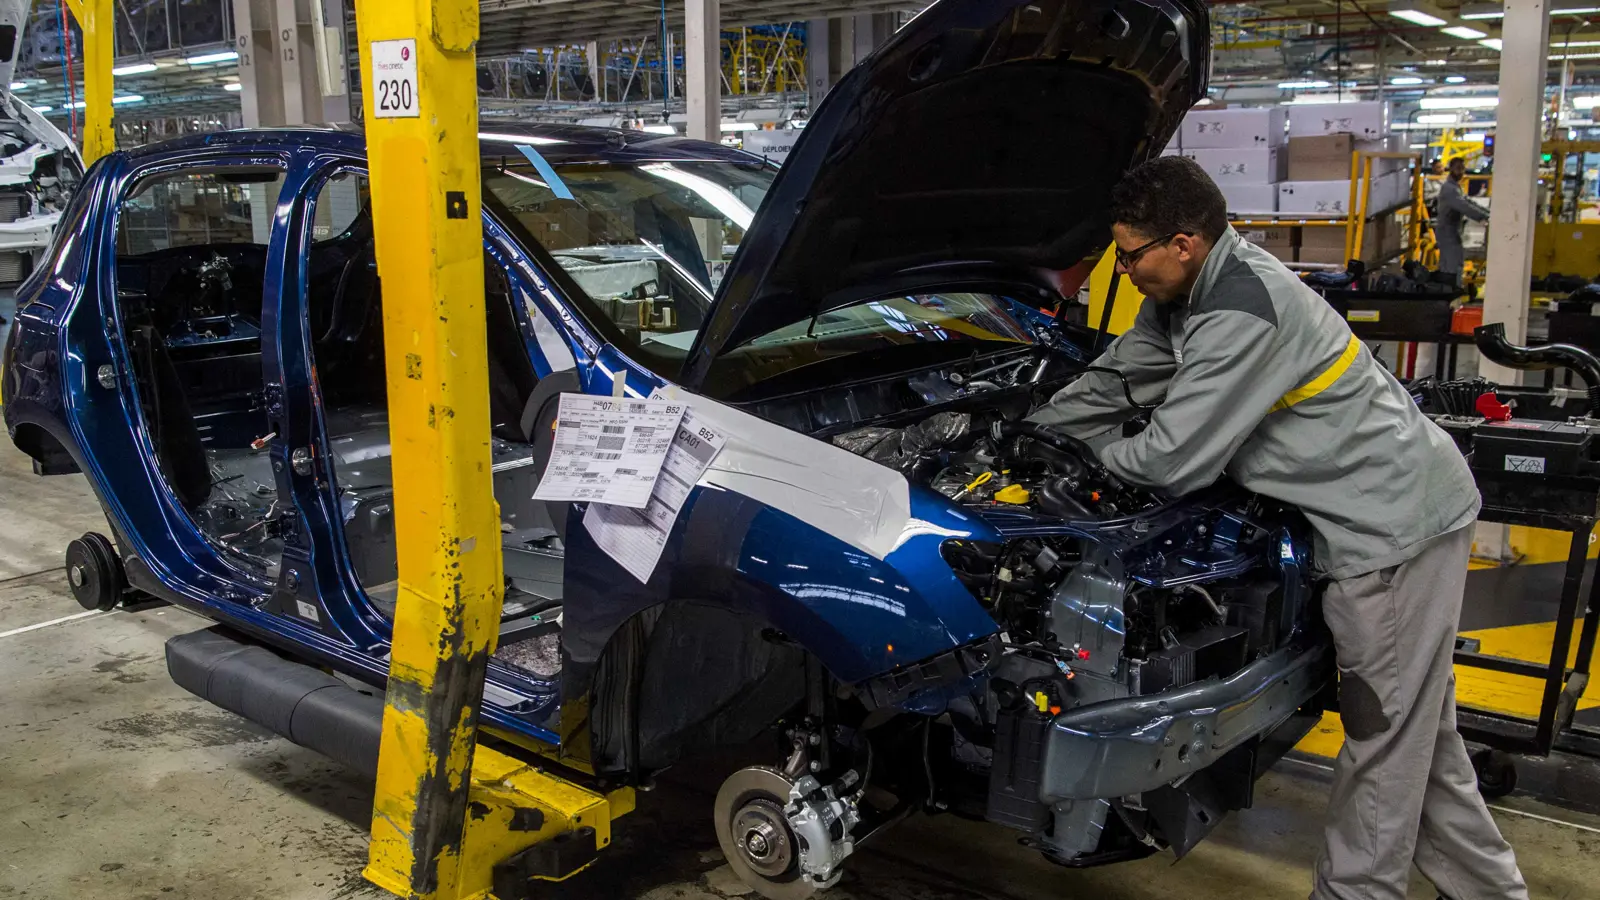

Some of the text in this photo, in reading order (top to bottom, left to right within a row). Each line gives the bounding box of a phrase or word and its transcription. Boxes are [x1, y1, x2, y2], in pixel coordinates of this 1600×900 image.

[241, 54, 250, 66] 12
[284, 48, 294, 60] 12
[379, 78, 412, 110] 230
[665, 405, 681, 414] B52
[679, 430, 700, 449] CA01
[698, 427, 714, 442] B52
